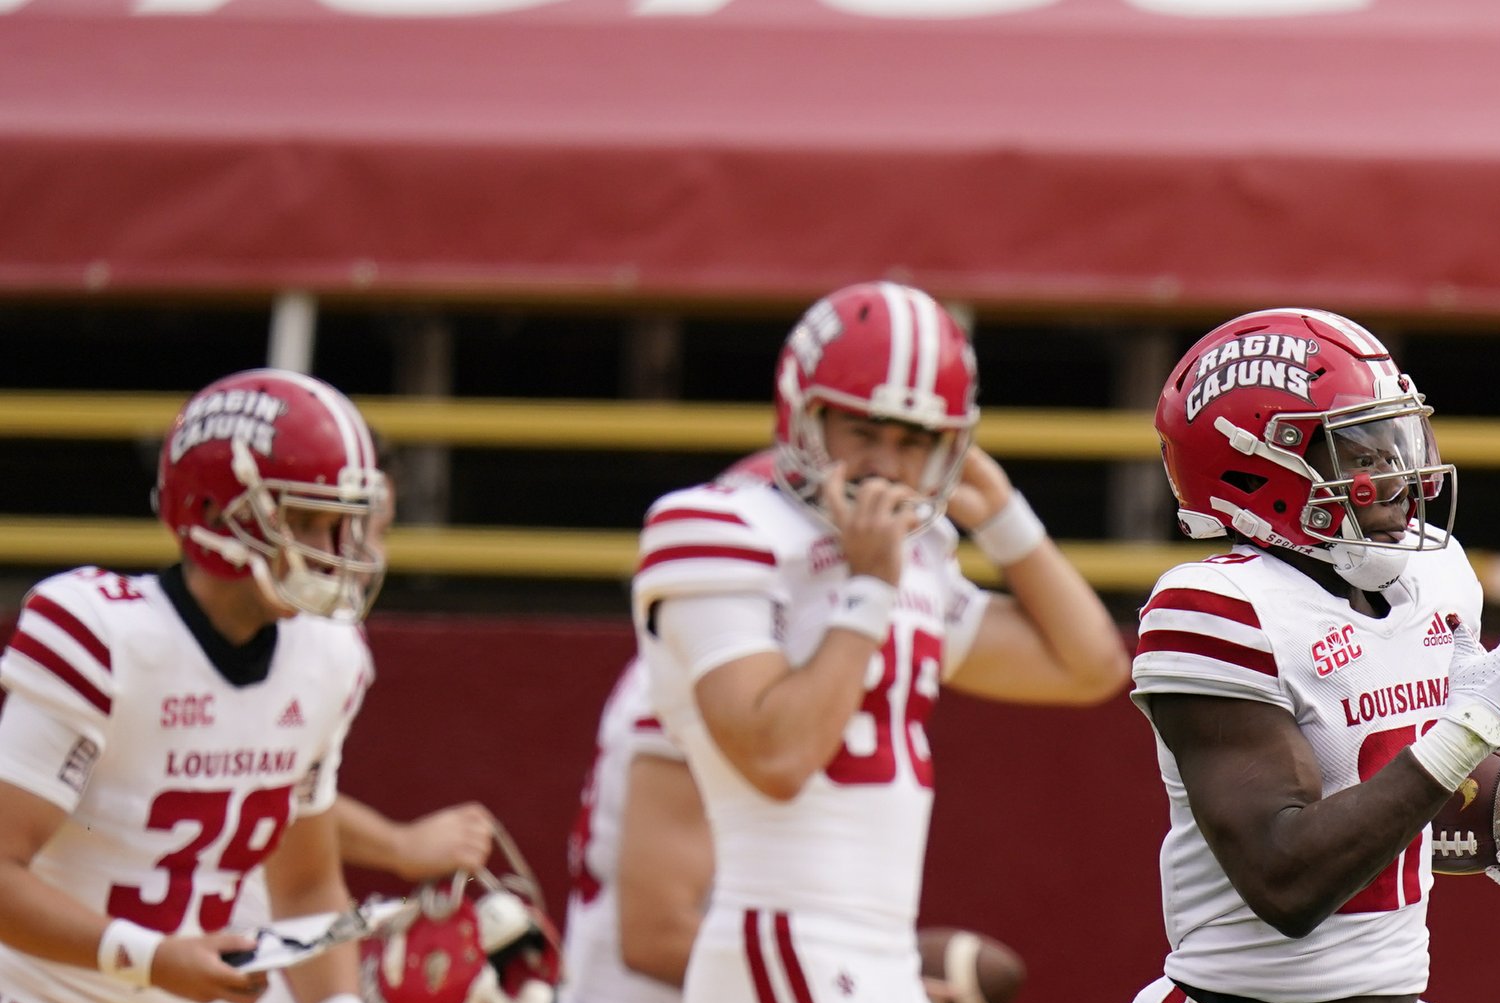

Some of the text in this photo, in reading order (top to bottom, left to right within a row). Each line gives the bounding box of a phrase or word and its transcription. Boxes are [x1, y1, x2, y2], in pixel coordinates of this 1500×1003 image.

[1197, 334, 1319, 377] RAGIN'
[1186, 360, 1310, 421] CAJUNS
[1312, 624, 1362, 676] SBC
[1423, 632, 1453, 647] adidas
[1340, 676, 1450, 728] LOUISIANA
[165, 752, 297, 777] LOUISIAN
[107, 784, 295, 934] 39
